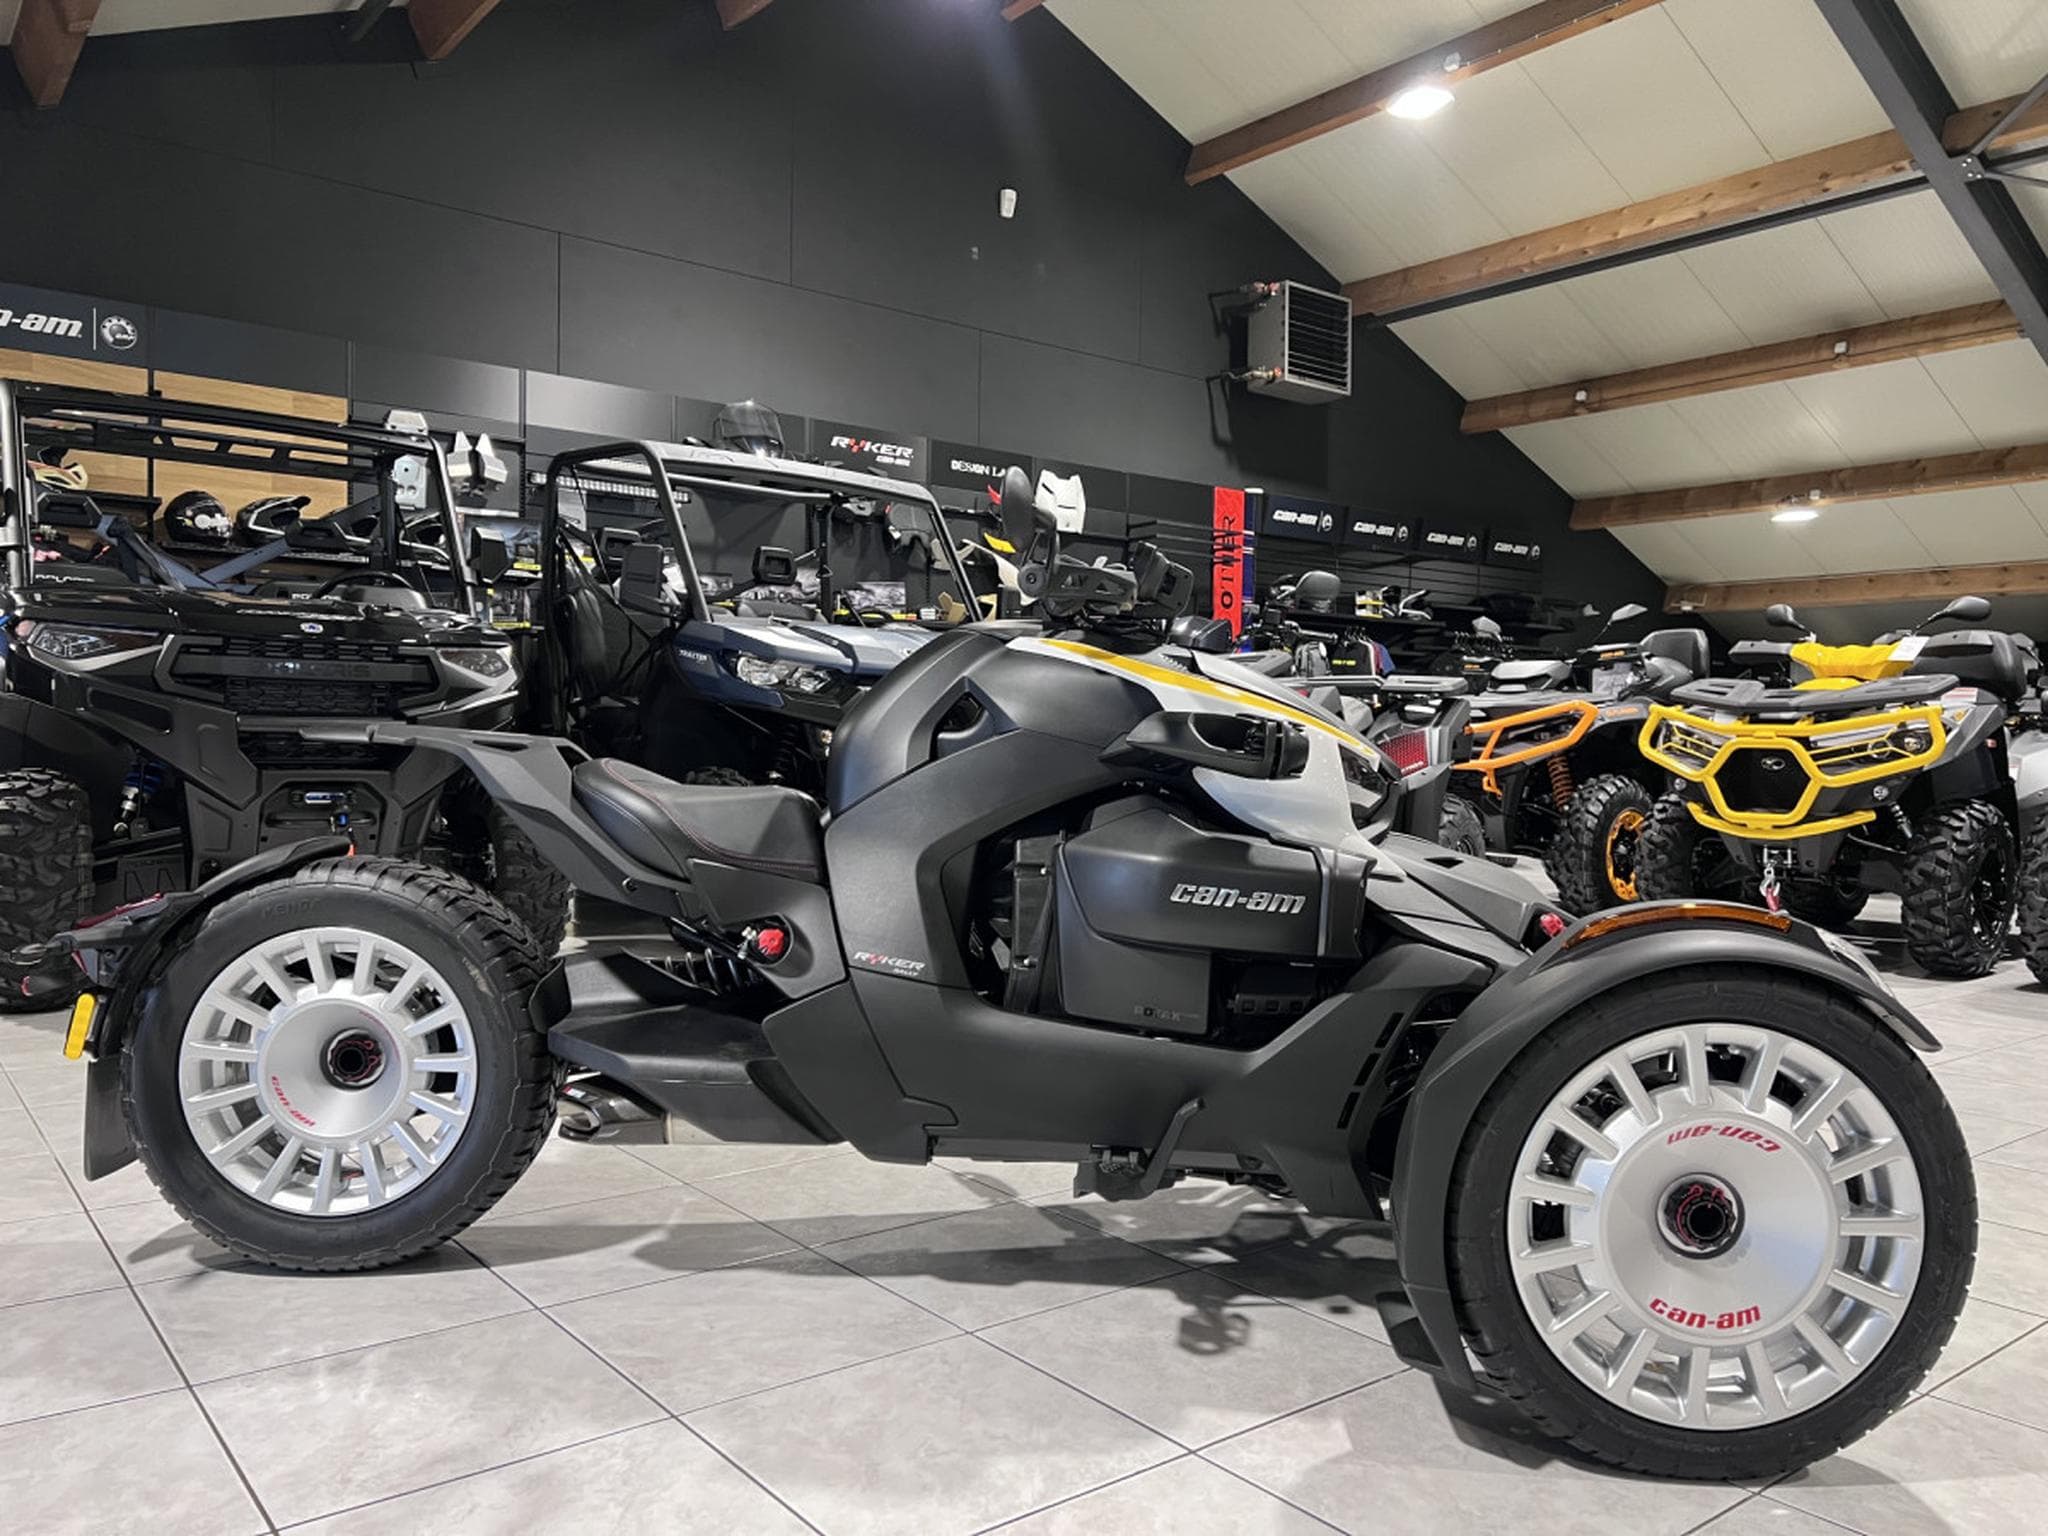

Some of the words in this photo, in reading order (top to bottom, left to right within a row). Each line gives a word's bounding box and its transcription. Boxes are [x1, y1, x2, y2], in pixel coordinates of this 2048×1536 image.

[830, 435, 914, 459] RYKER
[1273, 509, 1318, 526] can-am
[1170, 883, 1306, 914] can-am
[854, 951, 926, 970] RYKER
[1667, 1124, 1781, 1152] can-am
[1649, 1298, 1760, 1330] can-am
